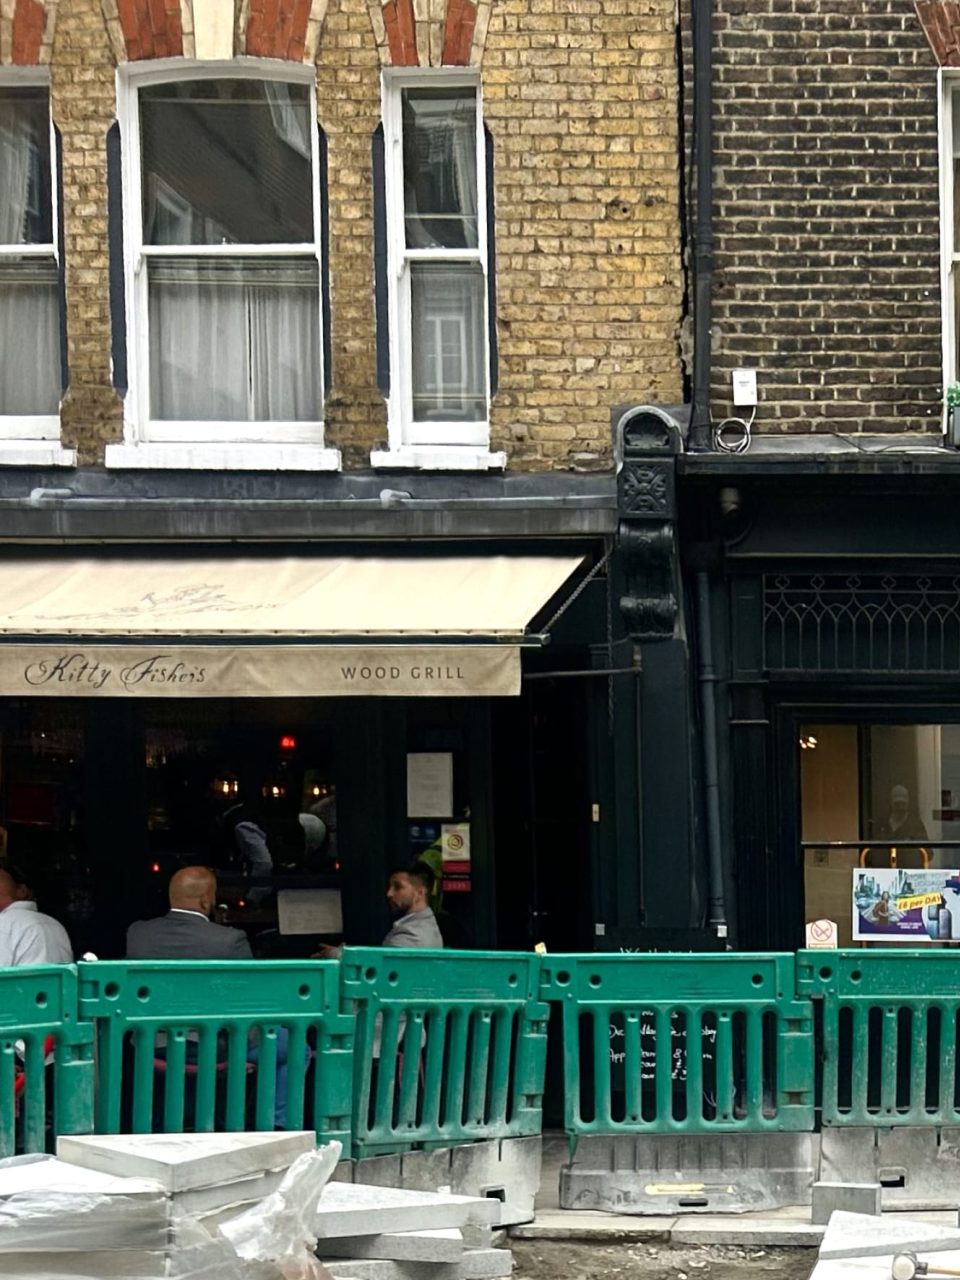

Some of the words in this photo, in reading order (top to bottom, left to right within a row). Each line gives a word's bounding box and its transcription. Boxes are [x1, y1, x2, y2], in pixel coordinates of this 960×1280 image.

[24, 653, 111, 688] Kitty
[341, 666, 400, 679] WOOD
[411, 666, 464, 679] GRILL
